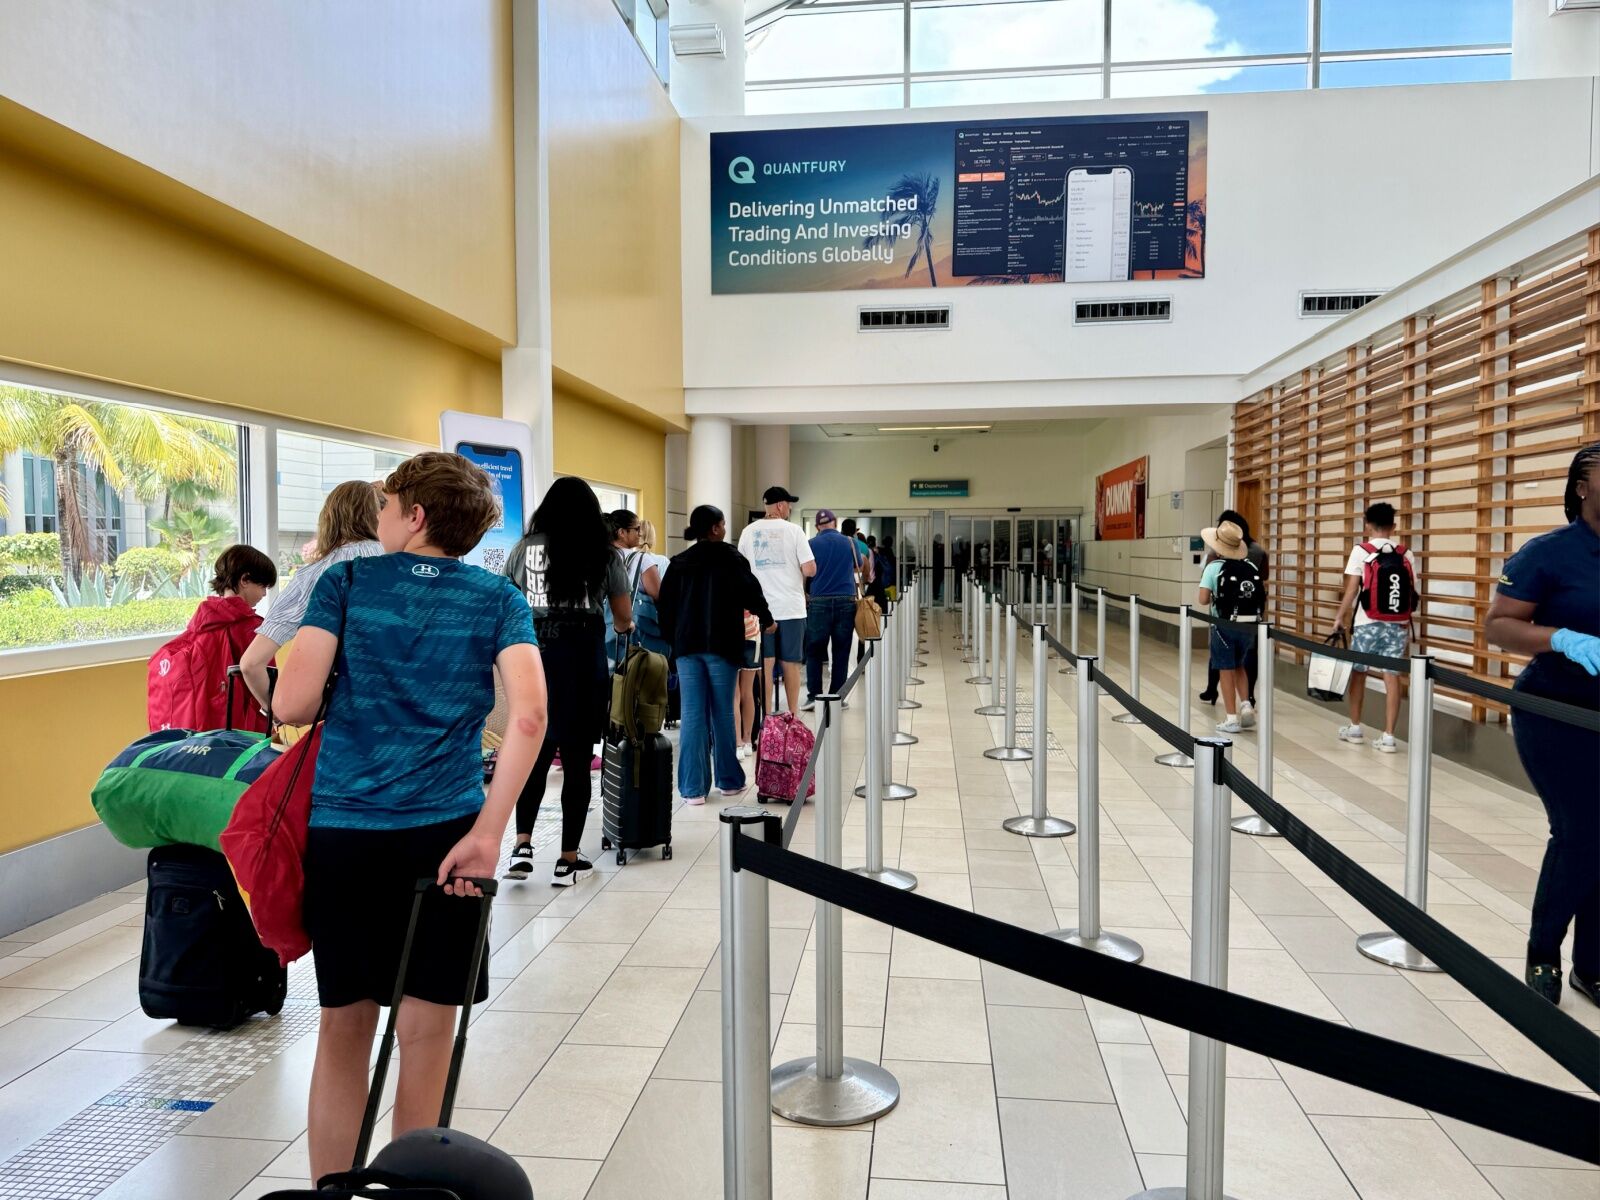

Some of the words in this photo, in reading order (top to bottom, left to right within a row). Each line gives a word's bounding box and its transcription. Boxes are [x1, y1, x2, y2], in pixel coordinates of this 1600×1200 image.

[763, 160, 847, 175] QUANTFURY
[729, 200, 815, 219] Delivering
[819, 194, 918, 215] Unmatched
[728, 225, 791, 244] Trading
[794, 223, 828, 240] And
[833, 221, 912, 239] Investing
[728, 248, 817, 266] Conditions
[822, 244, 894, 264] Globally
[1388, 573, 1401, 613] OAKLEY
